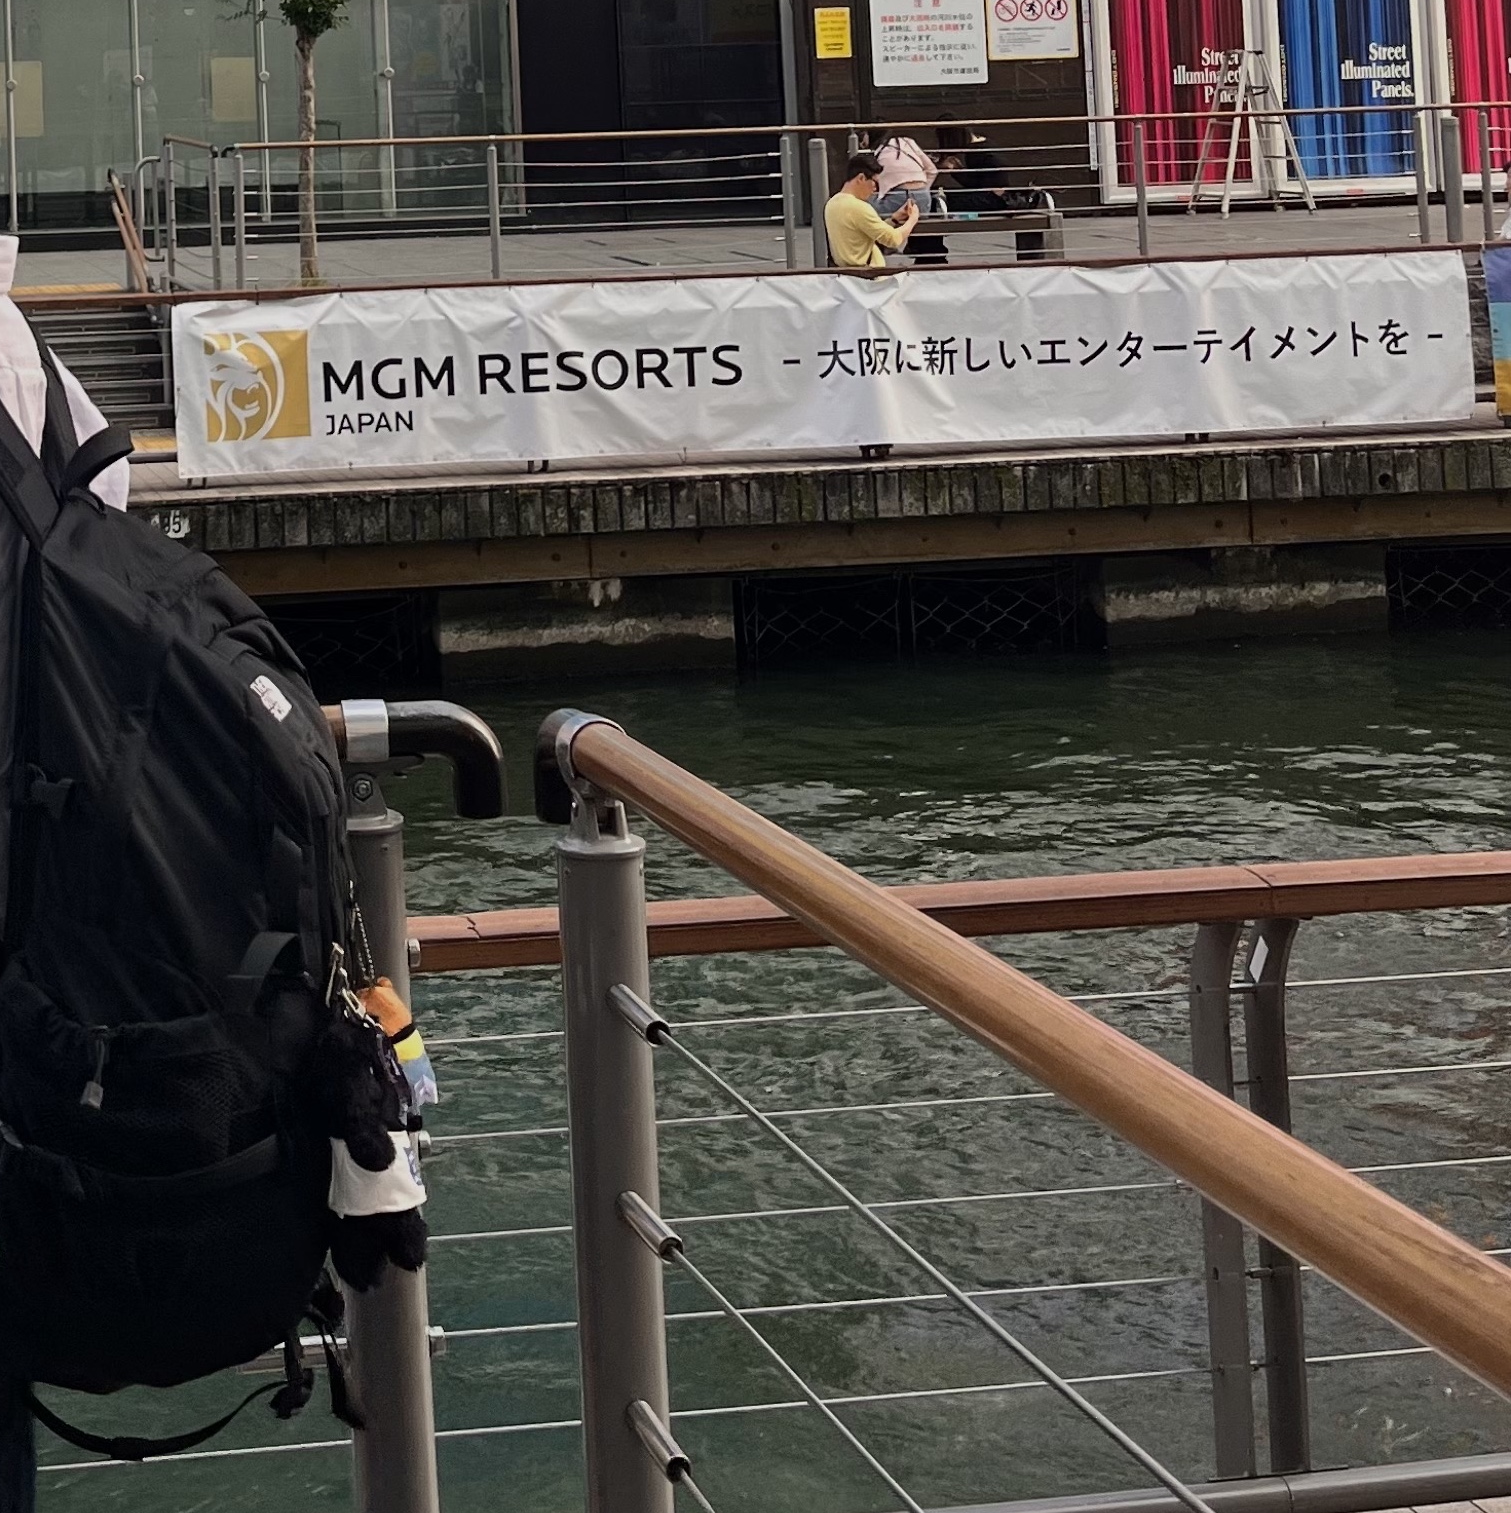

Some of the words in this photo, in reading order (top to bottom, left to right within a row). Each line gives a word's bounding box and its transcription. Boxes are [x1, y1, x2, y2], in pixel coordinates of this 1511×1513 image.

[1369, 42, 1407, 61] Street
[817, 318, 1411, 380] 大阪に新しいエンターテイメントを
[322, 355, 456, 403] MGM
[478, 345, 743, 394] RESORTS
[326, 410, 414, 436] JAPAN
